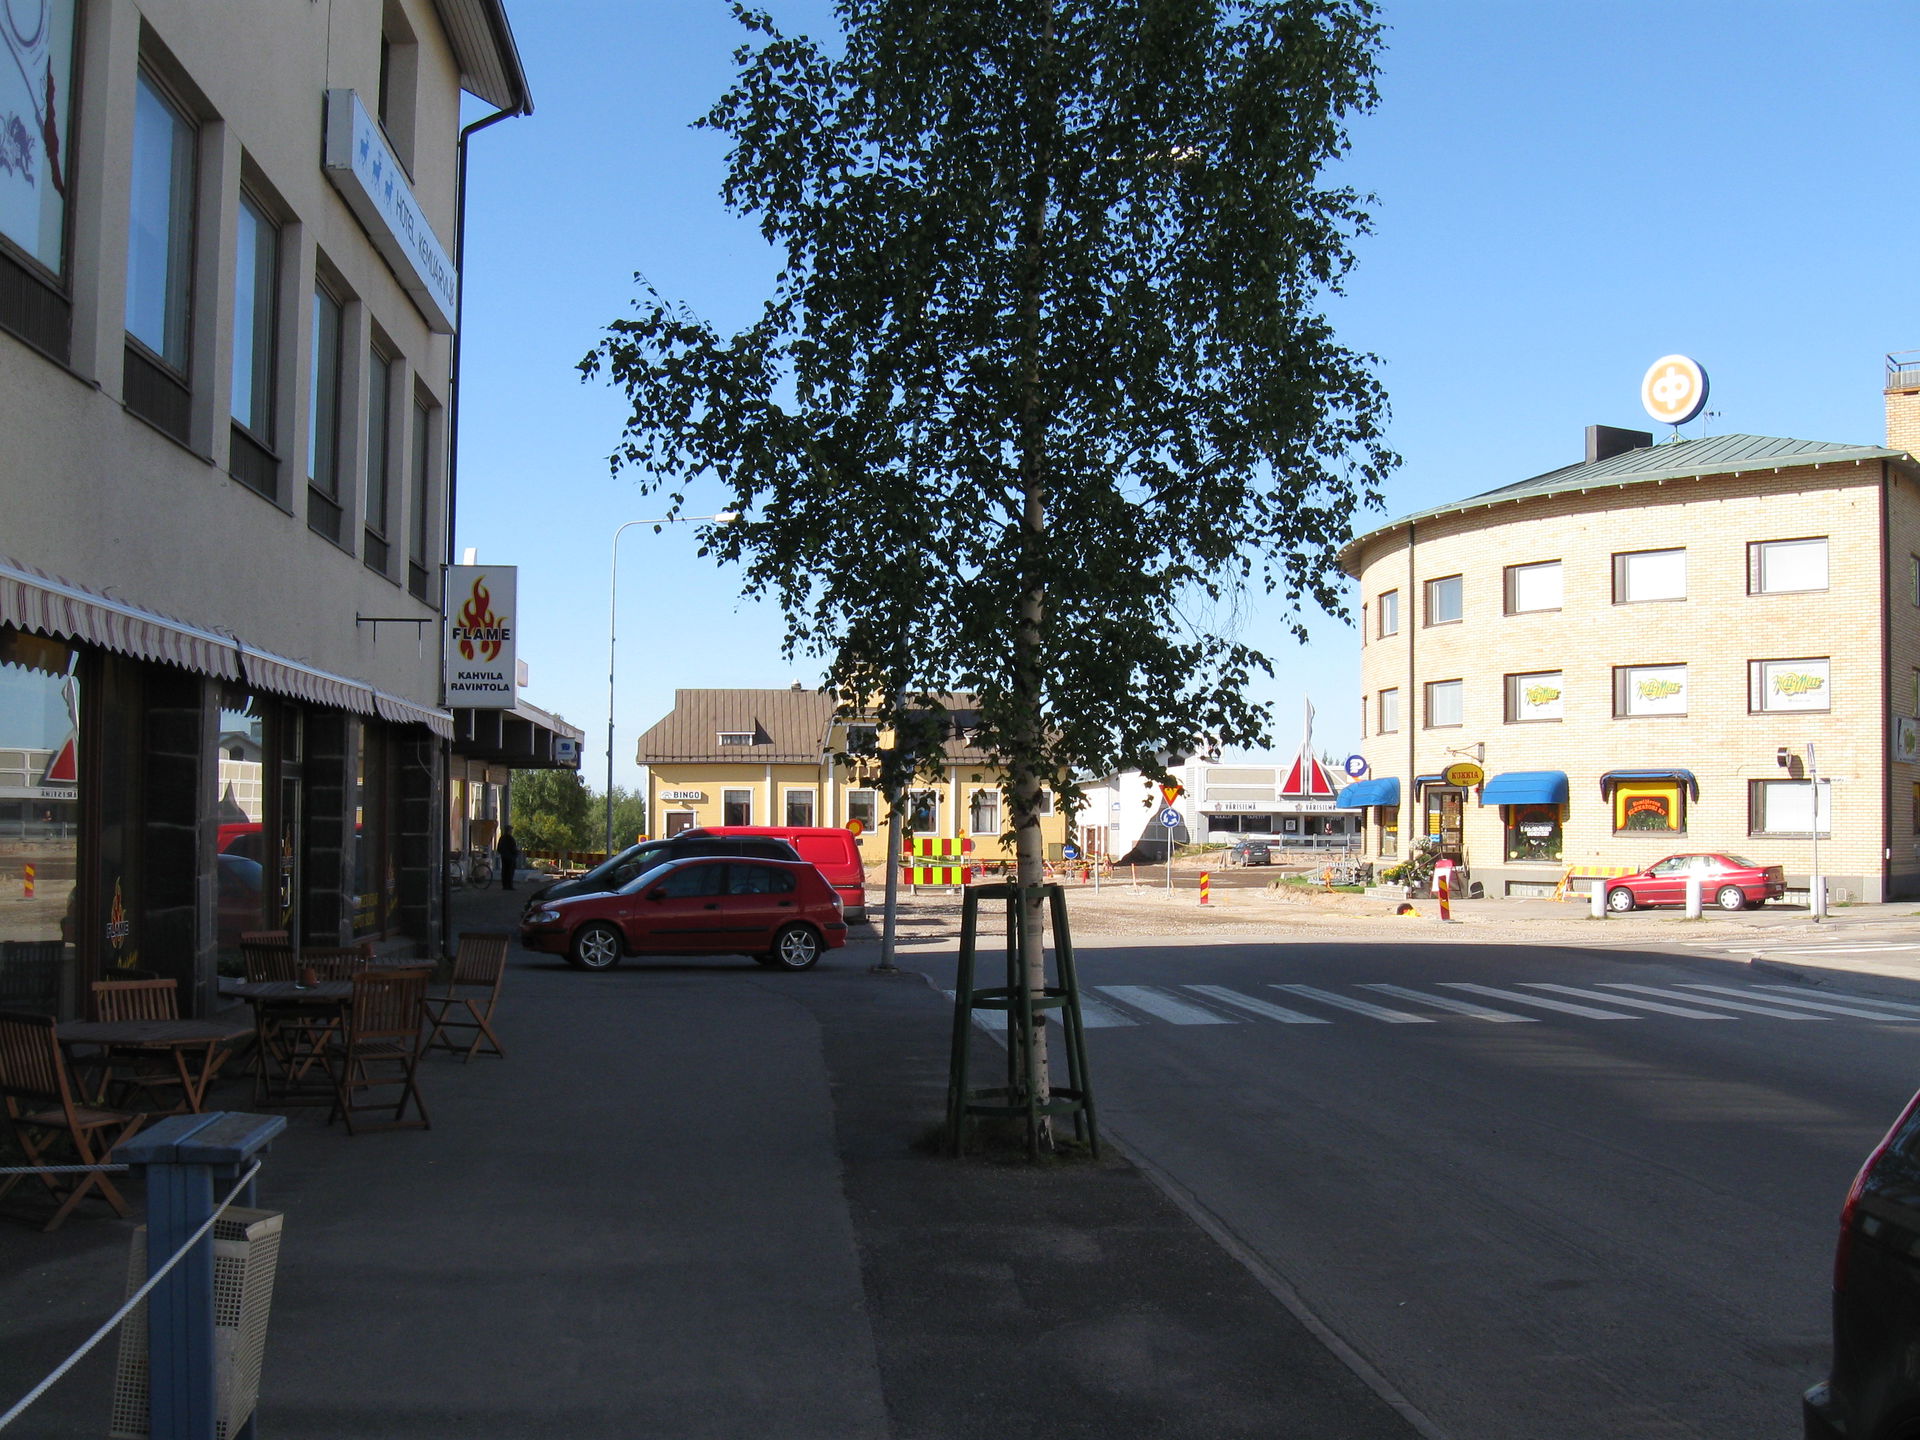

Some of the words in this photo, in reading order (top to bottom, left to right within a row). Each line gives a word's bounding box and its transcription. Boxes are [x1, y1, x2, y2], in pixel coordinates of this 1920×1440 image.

[396, 190, 415, 247] HOTEL
[452, 627, 511, 641] FLAME
[458, 671, 504, 681] KAHVILA
[451, 682, 511, 692] RAVINTOLA
[1451, 771, 1479, 780] KUKKIA
[673, 791, 700, 799] BINGO
[1225, 801, 1257, 811] VÄRISILMÄ
